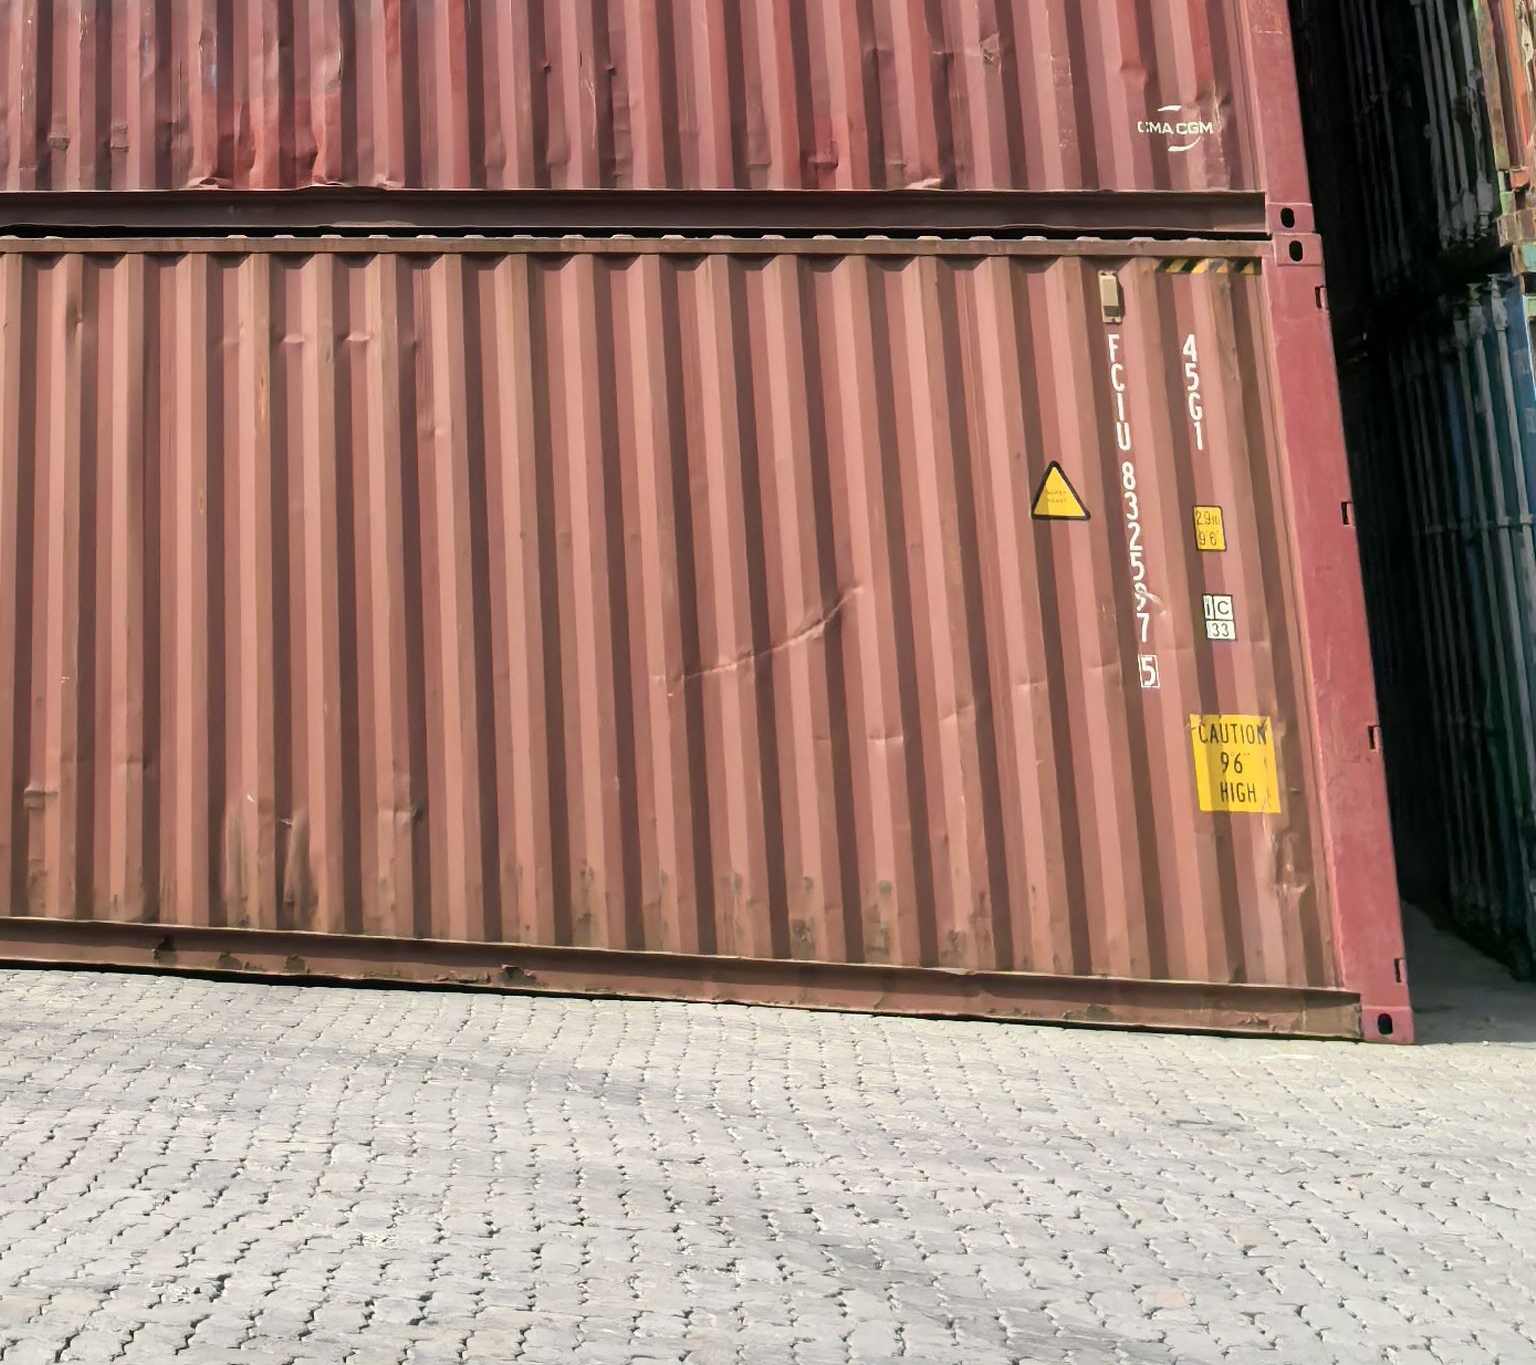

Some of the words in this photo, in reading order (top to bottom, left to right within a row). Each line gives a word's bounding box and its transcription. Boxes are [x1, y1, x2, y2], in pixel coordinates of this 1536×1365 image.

[1137, 120, 1174, 135] CMA
[1175, 120, 1214, 135] CGM
[1181, 333, 1204, 451] 45G1
[1107, 333, 1131, 451] FCIU
[1121, 461, 1150, 642] 832597
[1140, 657, 1157, 687] 5
[1211, 622, 1230, 638] 33
[1198, 722, 1267, 745] CAUTION
[1219, 781, 1257, 803] HIGH
